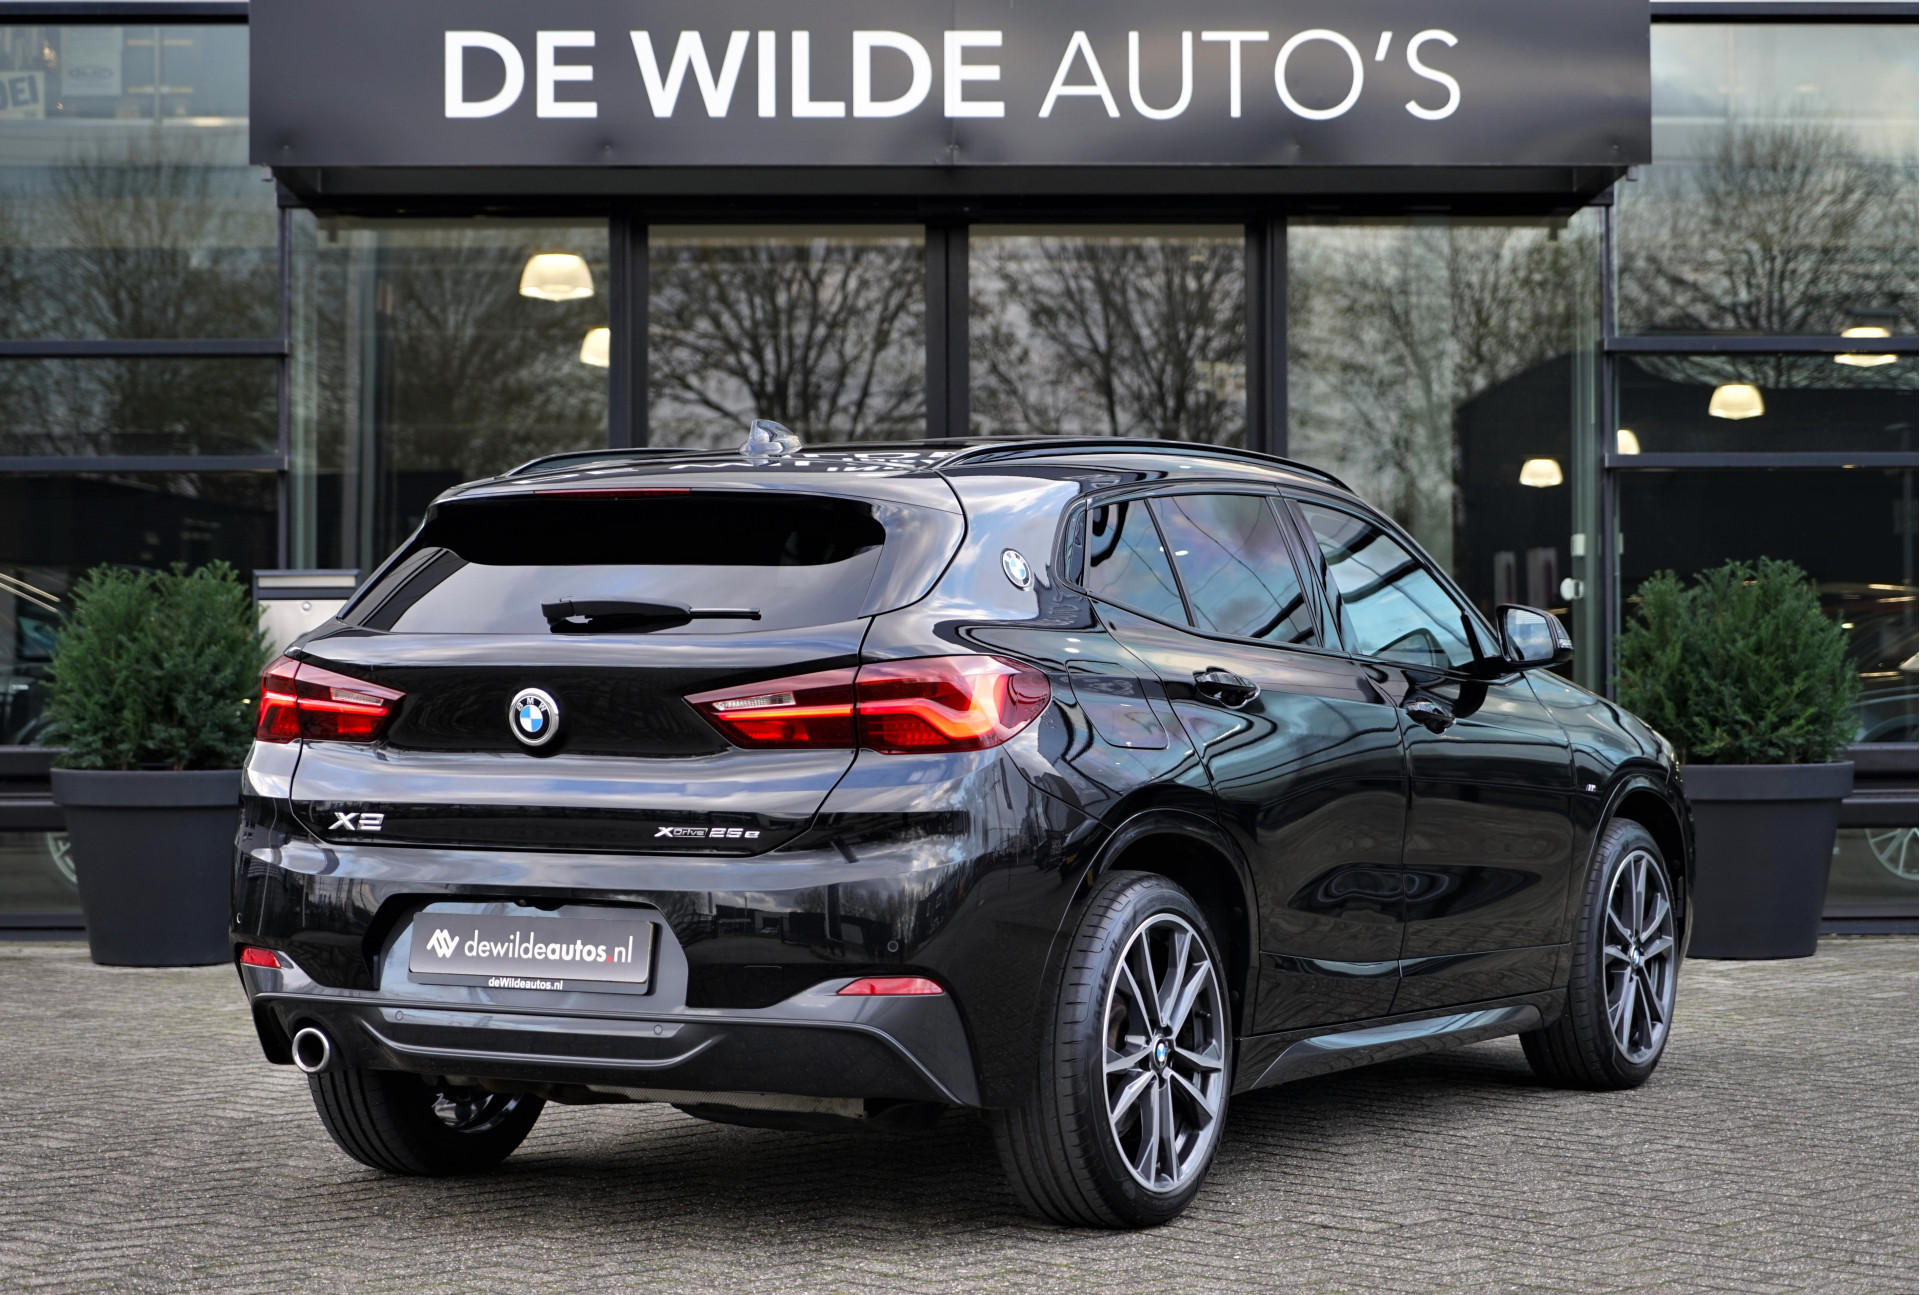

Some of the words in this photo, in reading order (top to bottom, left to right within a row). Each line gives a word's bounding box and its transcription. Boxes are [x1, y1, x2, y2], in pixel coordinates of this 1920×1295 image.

[445, 30, 598, 118] DE
[629, 30, 1005, 118] WILDE
[1038, 28, 1461, 120] AUTO'S
[516, 697, 547, 711] BMW
[328, 811, 385, 831] X2
[464, 929, 633, 963] dewildeautos.nl
[488, 976, 564, 991] deWildeautos.nl
